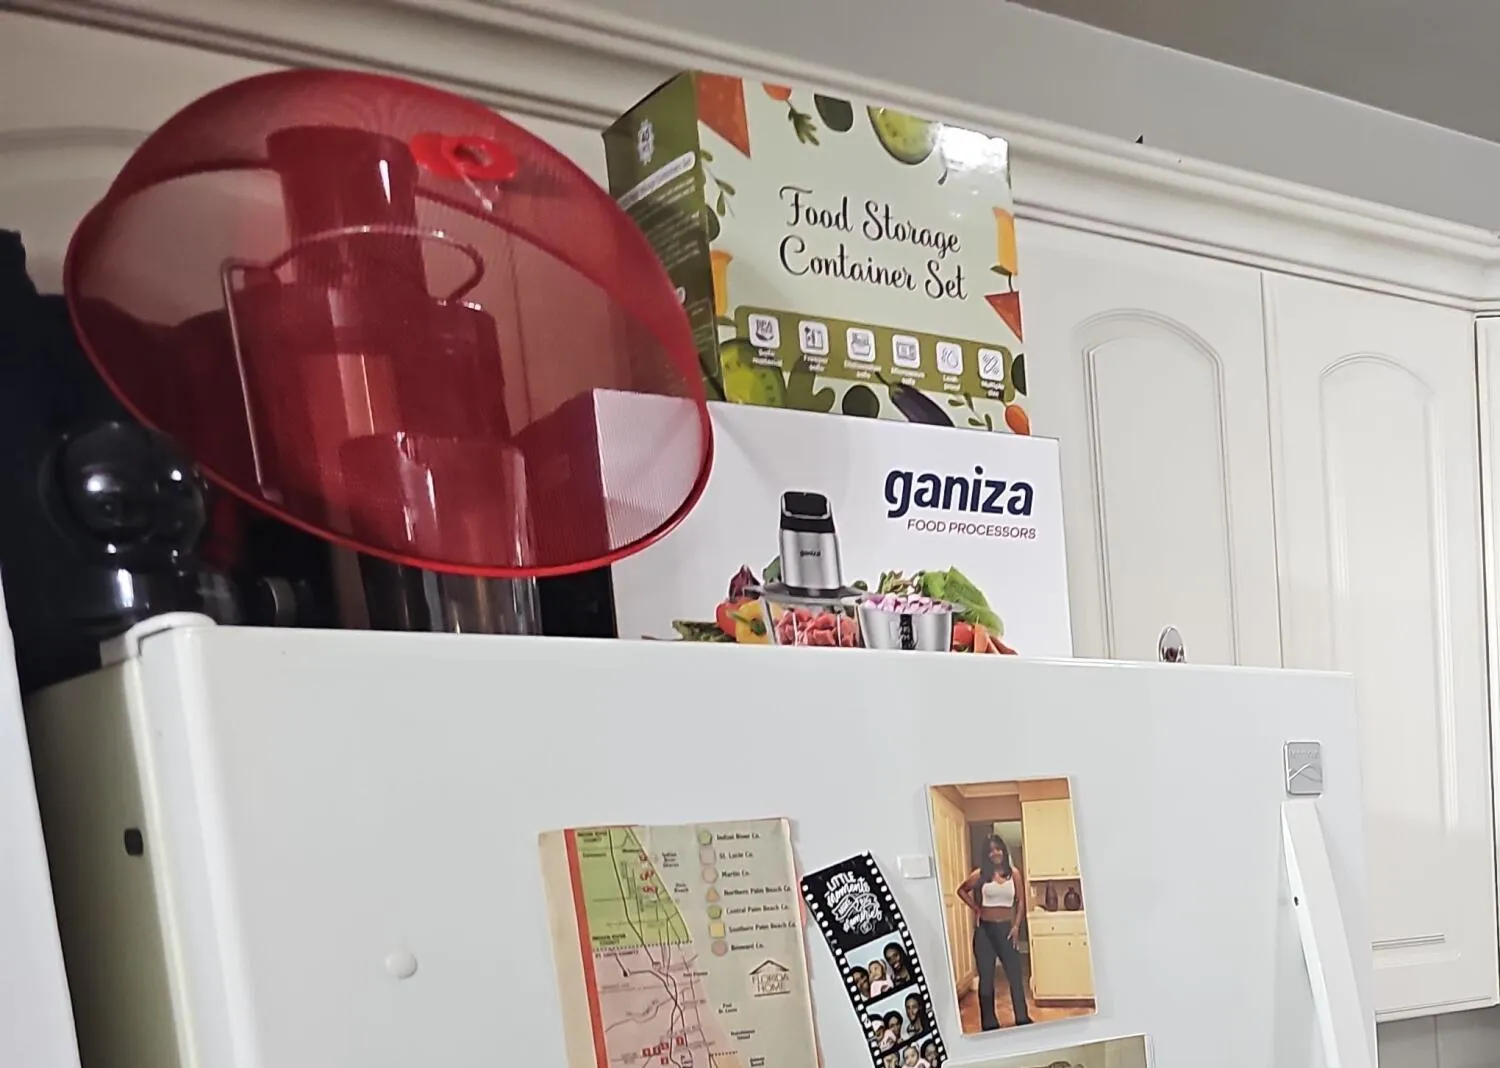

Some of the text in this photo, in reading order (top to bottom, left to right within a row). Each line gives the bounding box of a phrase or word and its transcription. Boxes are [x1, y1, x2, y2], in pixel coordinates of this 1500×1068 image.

[779, 186, 961, 259] Food Storage
[780, 235, 967, 300] Container Set
[884, 465, 1034, 518] ganiza
[907, 519, 1036, 540] FOOD PROCESSORS
